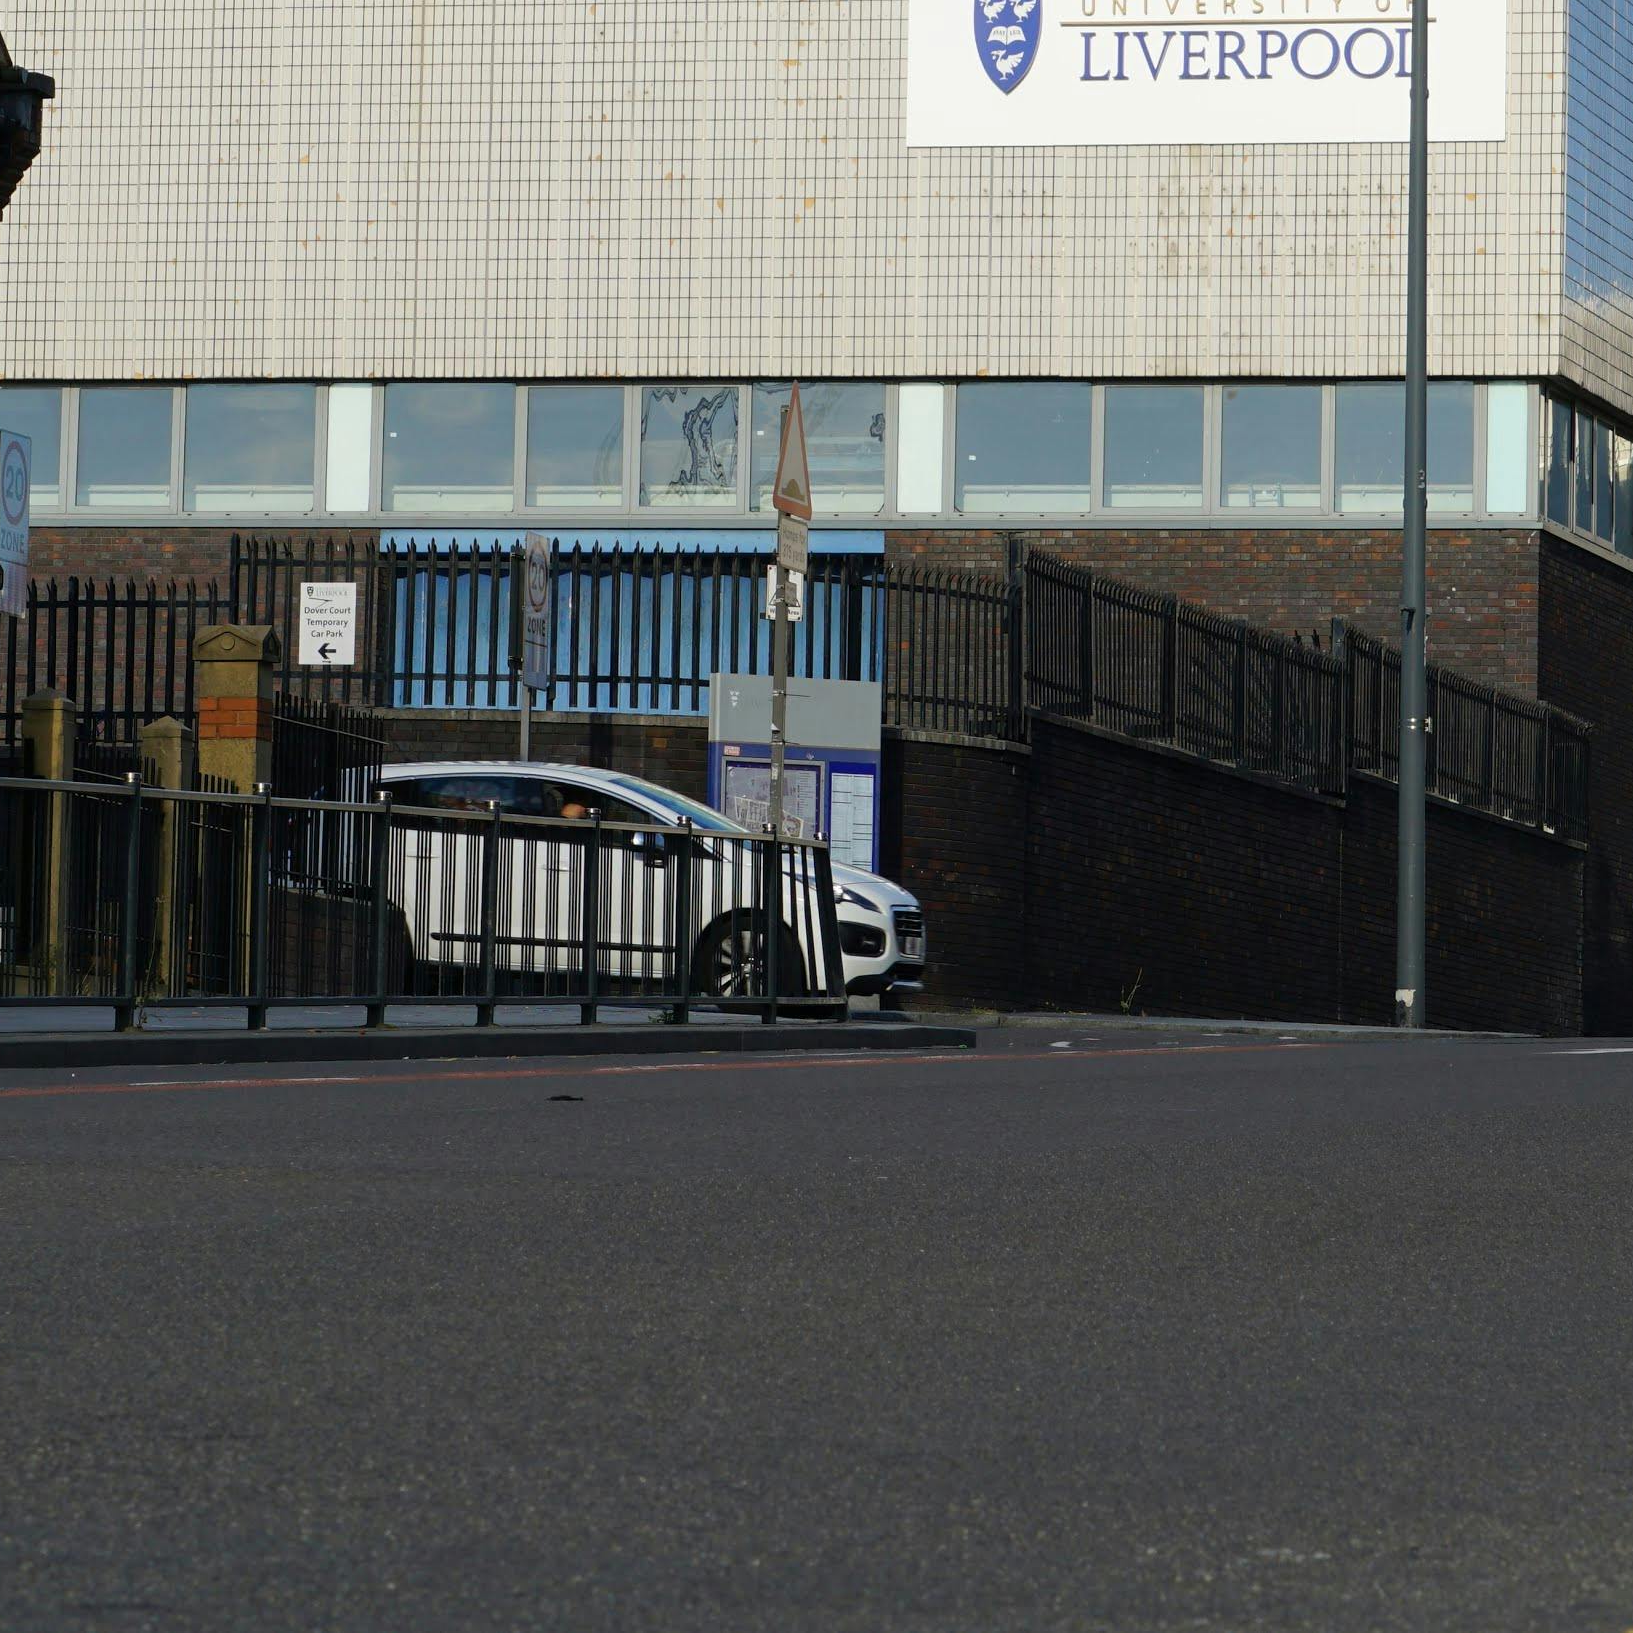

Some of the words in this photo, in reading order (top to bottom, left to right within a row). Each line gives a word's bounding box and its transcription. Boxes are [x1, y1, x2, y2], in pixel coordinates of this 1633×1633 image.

[1079, 27, 1413, 81] LIVERPOOL
[5, 463, 24, 502] 20
[0, 528, 25, 554] ZONE
[531, 561, 545, 590] 20
[304, 606, 328, 614] Dover
[329, 606, 351, 614] Court
[306, 619, 348, 627] Temporary
[527, 617, 546, 637] ZONE
